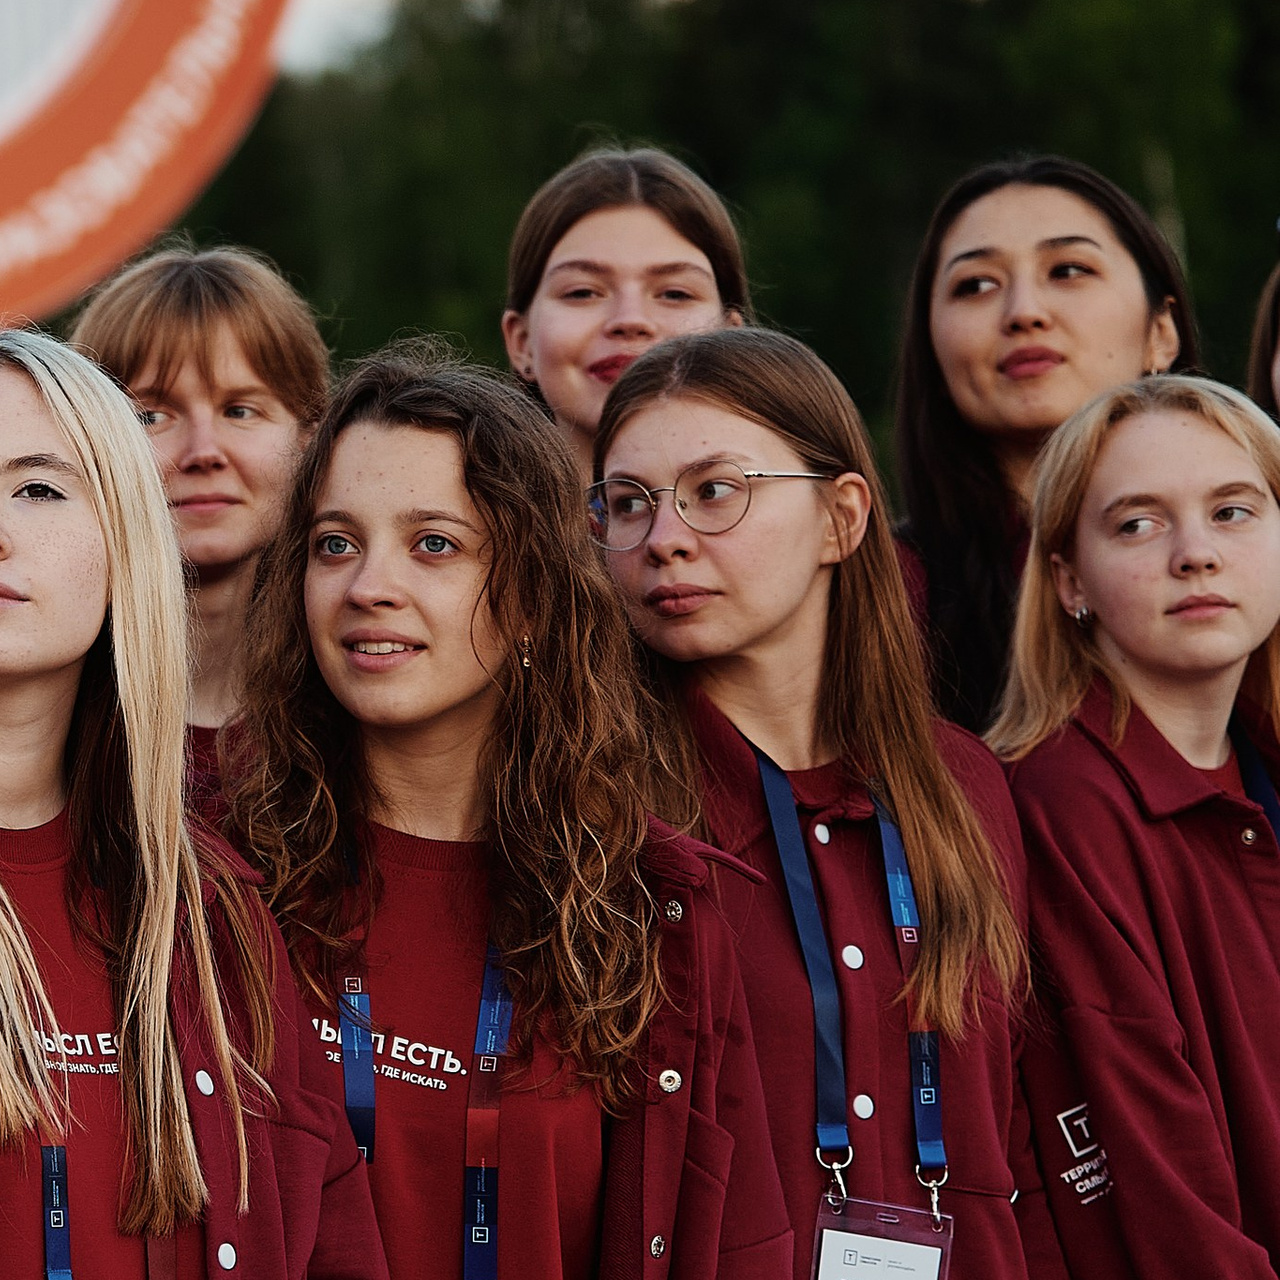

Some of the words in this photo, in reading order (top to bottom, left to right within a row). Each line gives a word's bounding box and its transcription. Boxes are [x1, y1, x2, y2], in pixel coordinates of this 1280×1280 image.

[390, 1036, 468, 1076] ЕСТЬ.
[380, 1064, 401, 1079] ГДЕ
[401, 1070, 448, 1091] ИСКАТЬ
